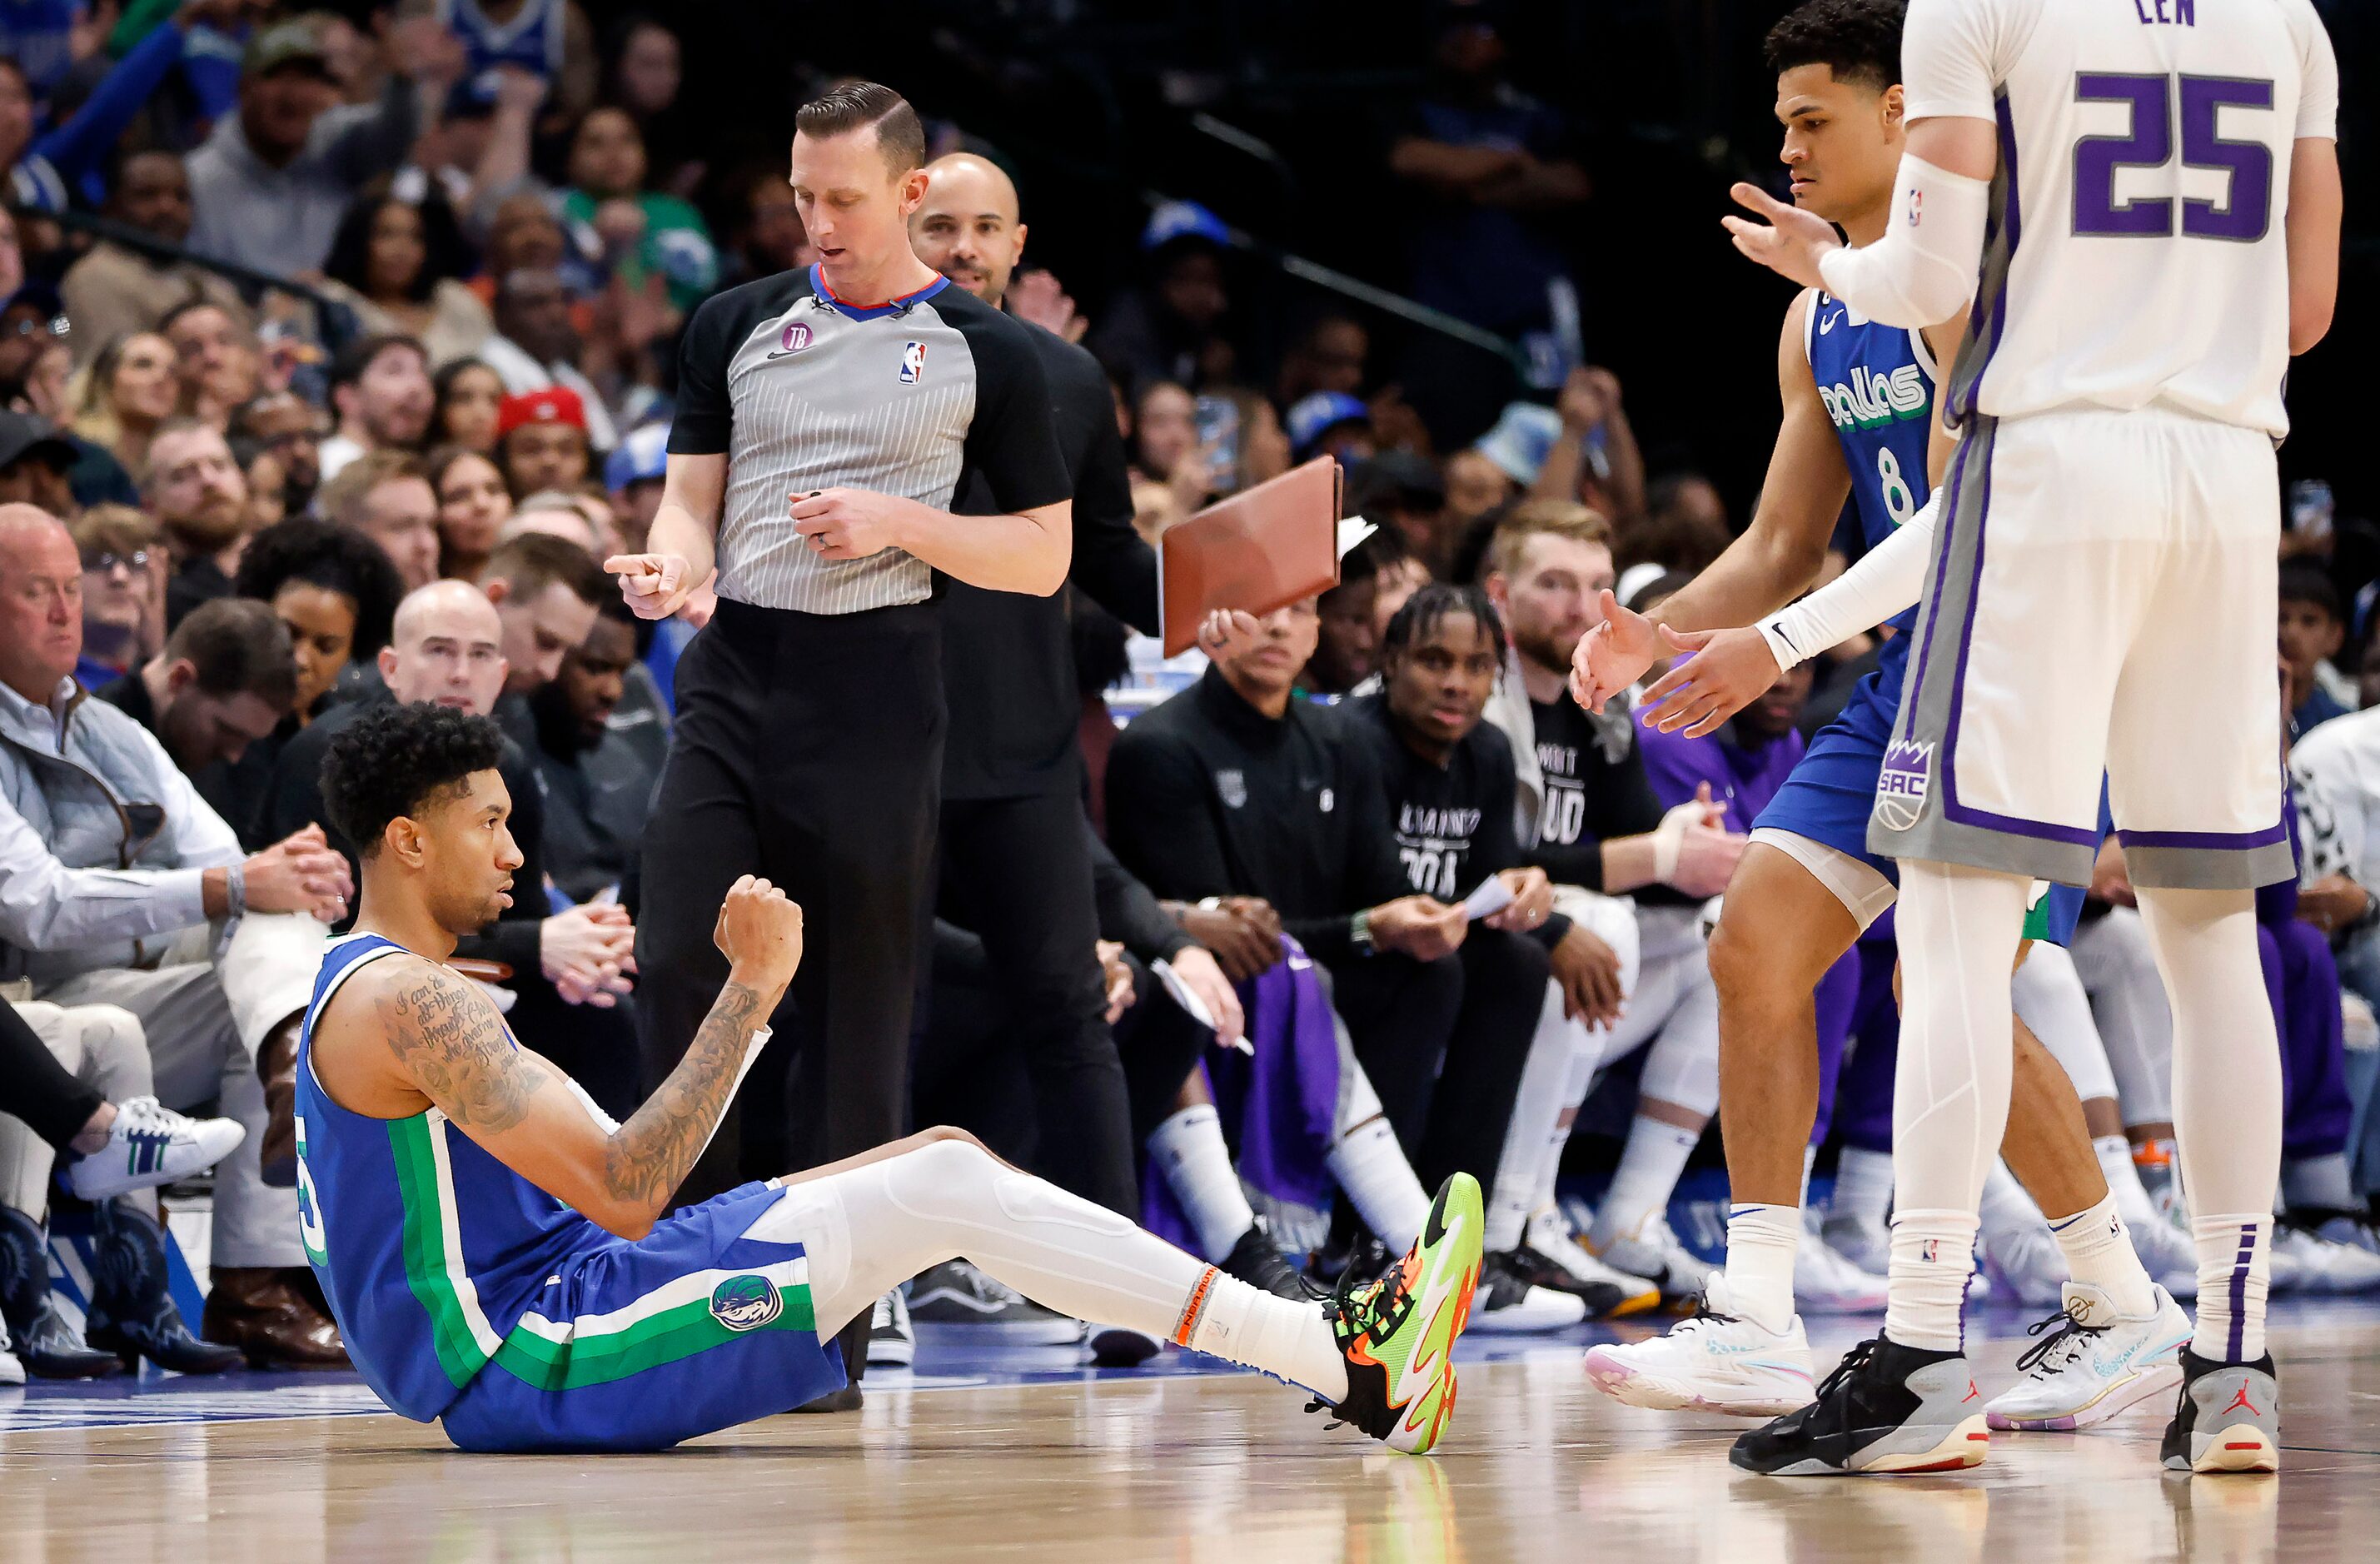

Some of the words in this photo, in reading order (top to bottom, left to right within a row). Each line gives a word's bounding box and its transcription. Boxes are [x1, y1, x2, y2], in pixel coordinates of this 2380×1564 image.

[2134, 0, 2194, 27] LEN
[2071, 70, 2274, 244] 25
[789, 326, 807, 349] TB
[1878, 447, 1914, 526] 8
[1880, 773, 1925, 795] SAC
